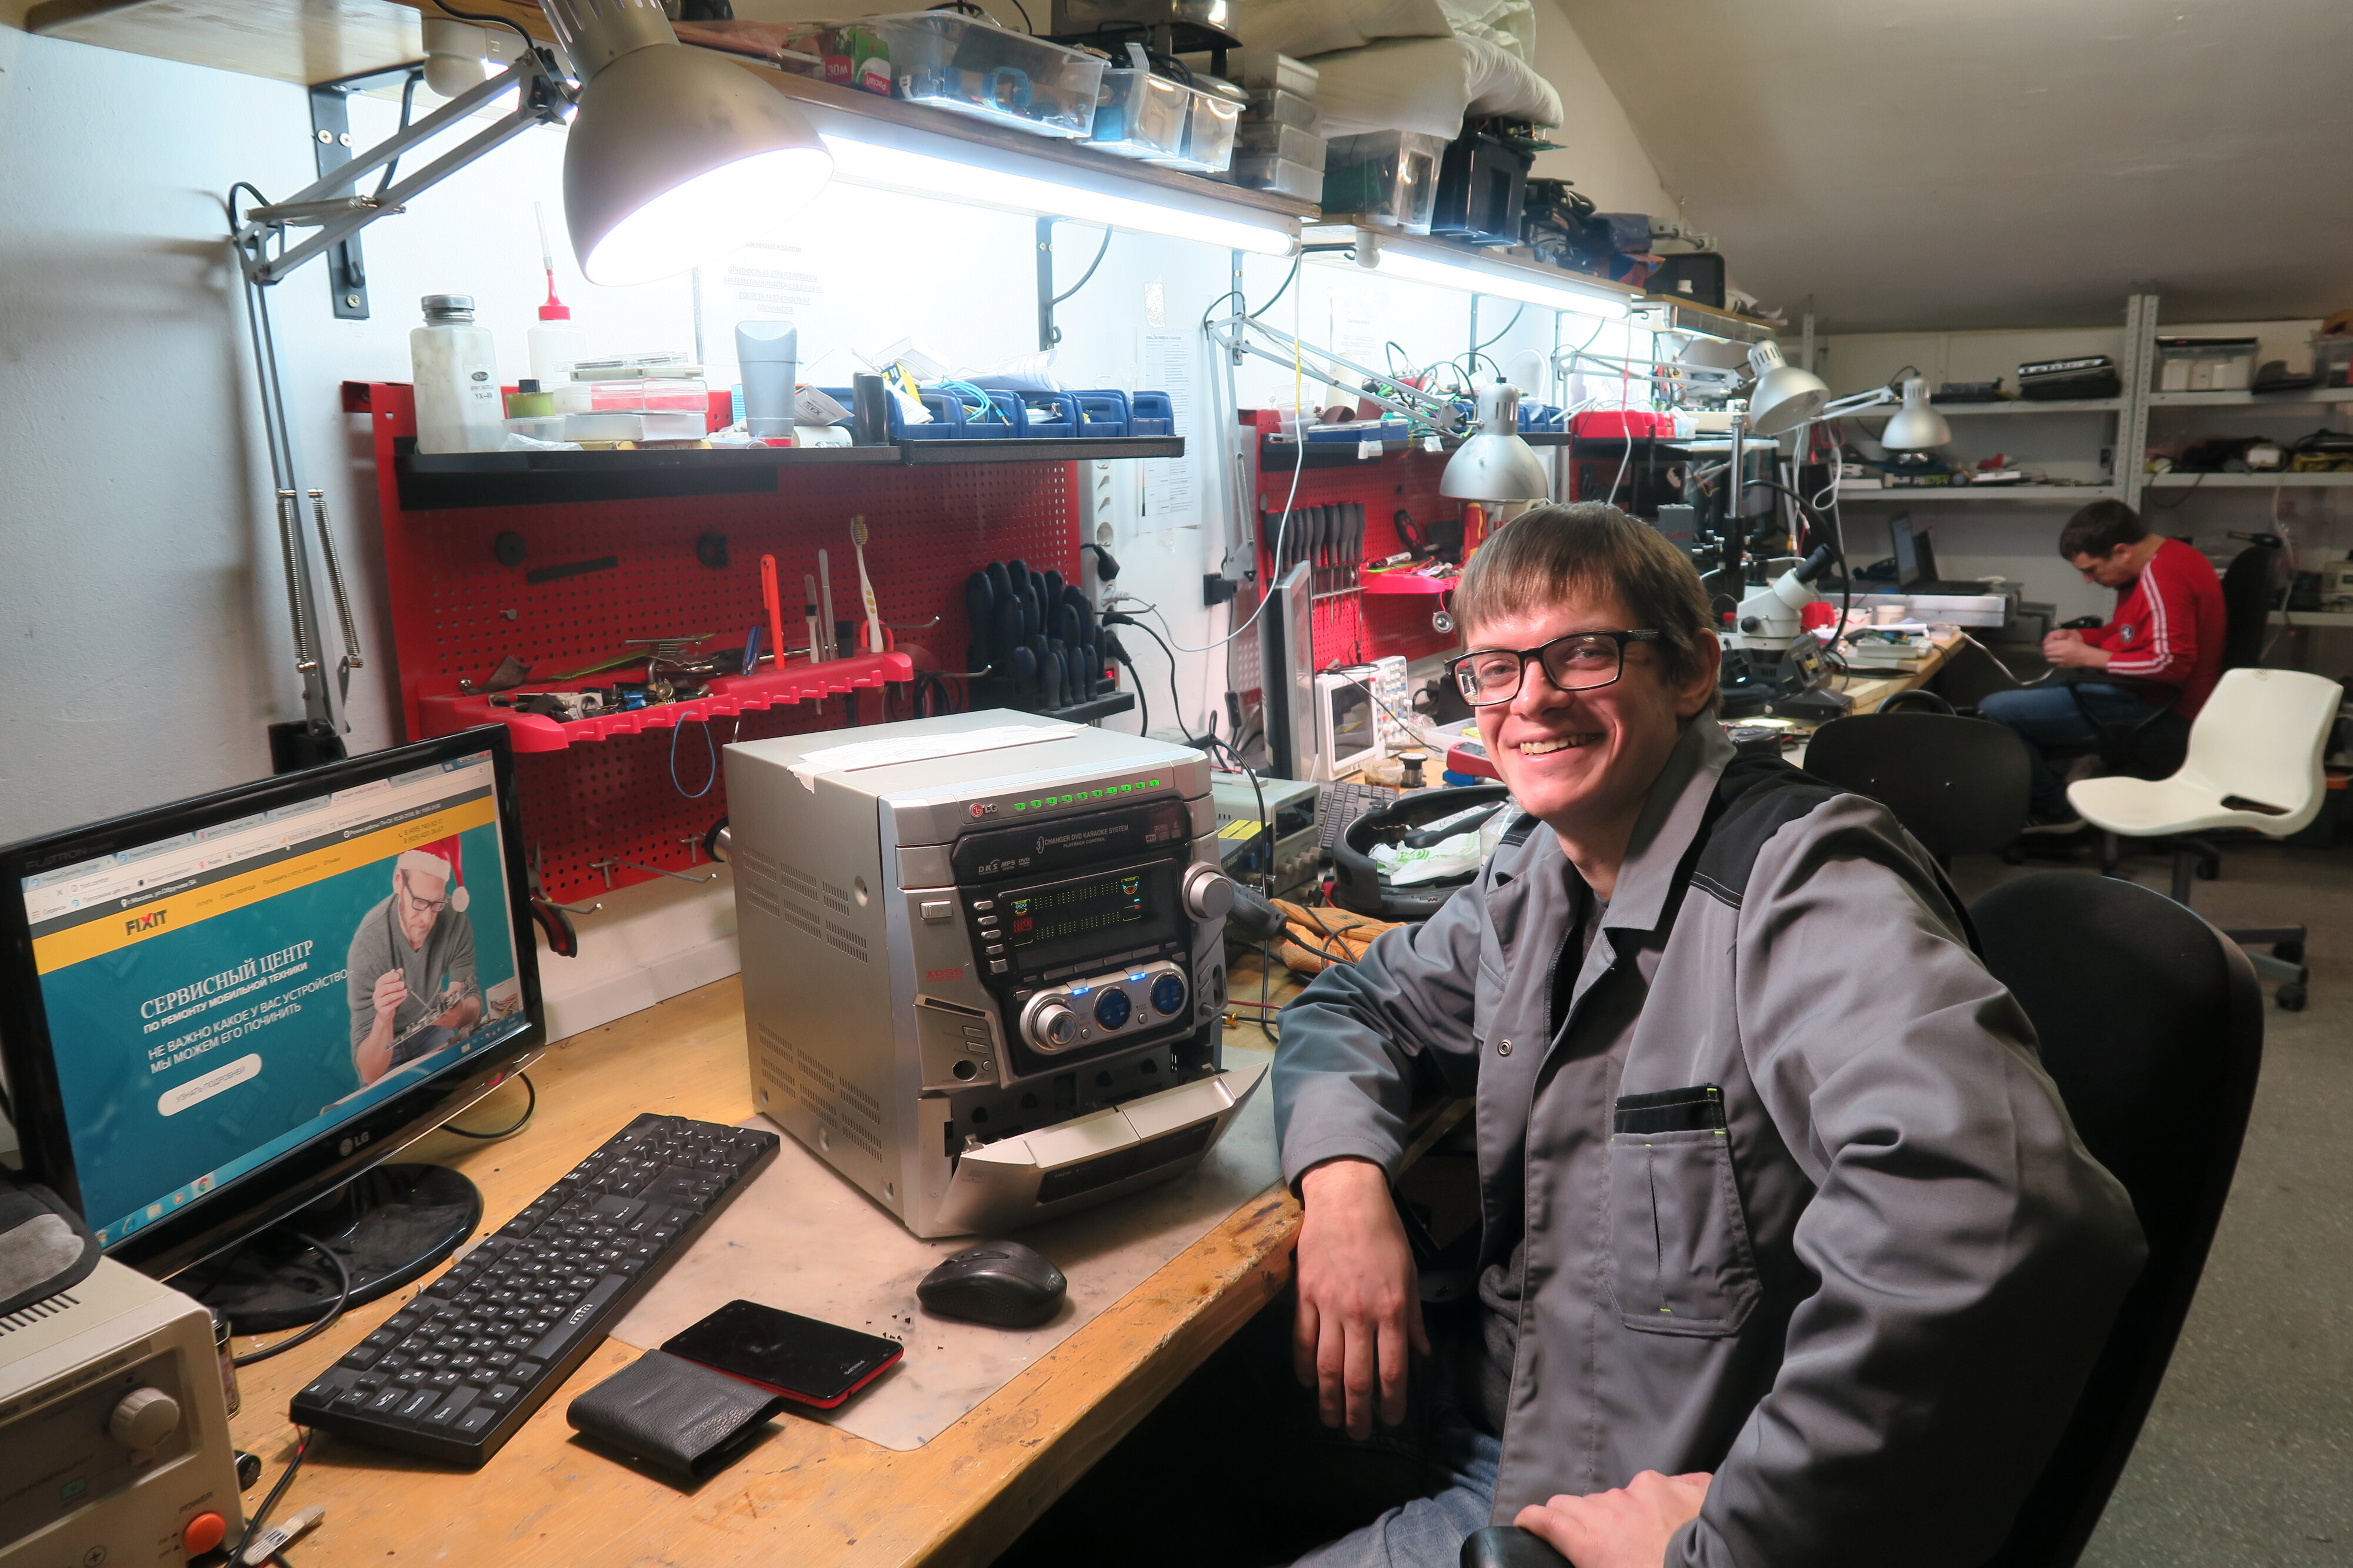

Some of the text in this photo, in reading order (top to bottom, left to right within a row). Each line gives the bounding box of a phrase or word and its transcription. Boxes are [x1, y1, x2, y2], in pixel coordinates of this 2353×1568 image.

[865, 75, 886, 91] Paclan
[728, 266, 762, 275] ОТЧЕТНОСТЬ
[770, 270, 784, 278] ДЕНЬ
[792, 272, 818, 282] ГОТОВЫМ
[724, 276, 749, 285] ЗАКАЗАМ
[749, 279, 787, 289] ПРИНИМАЕТСЯ
[772, 294, 803, 303] ОТЧЕТНОСТЬ
[985, 805, 998, 813] LG
[1036, 840, 1041, 850] 3
[1044, 835, 1071, 846] CHANGER
[1083, 828, 1108, 838] KARAOKE
[1109, 824, 1129, 834] SYSTEM
[978, 862, 999, 873] DKS
[125, 910, 167, 936] FIXIT
[141, 939, 314, 1020] СЕРВИСНЫЙ ЦЕНТР
[926, 968, 964, 978] XDSS
[144, 961, 308, 1034] ПО РЕМОНТУ МОБИЛЬНОЙ ТЕХНИКИ
[148, 1045, 165, 1060] НЕ
[166, 1026, 212, 1053] ВАЖНО
[213, 1011, 250, 1033] КАКОЕ
[250, 1006, 259, 1018] У
[260, 996, 282, 1013] ВАС
[283, 969, 348, 1004] УСТРОЙСТВО
[151, 1002, 302, 1075] МЫ МОЖЕМ ЕГО ПОЧИНИТЬ
[175, 1086, 203, 1103] УЗНАТЬ
[355, 1131, 369, 1147] LG
[179, 1492, 214, 1514] POWER
